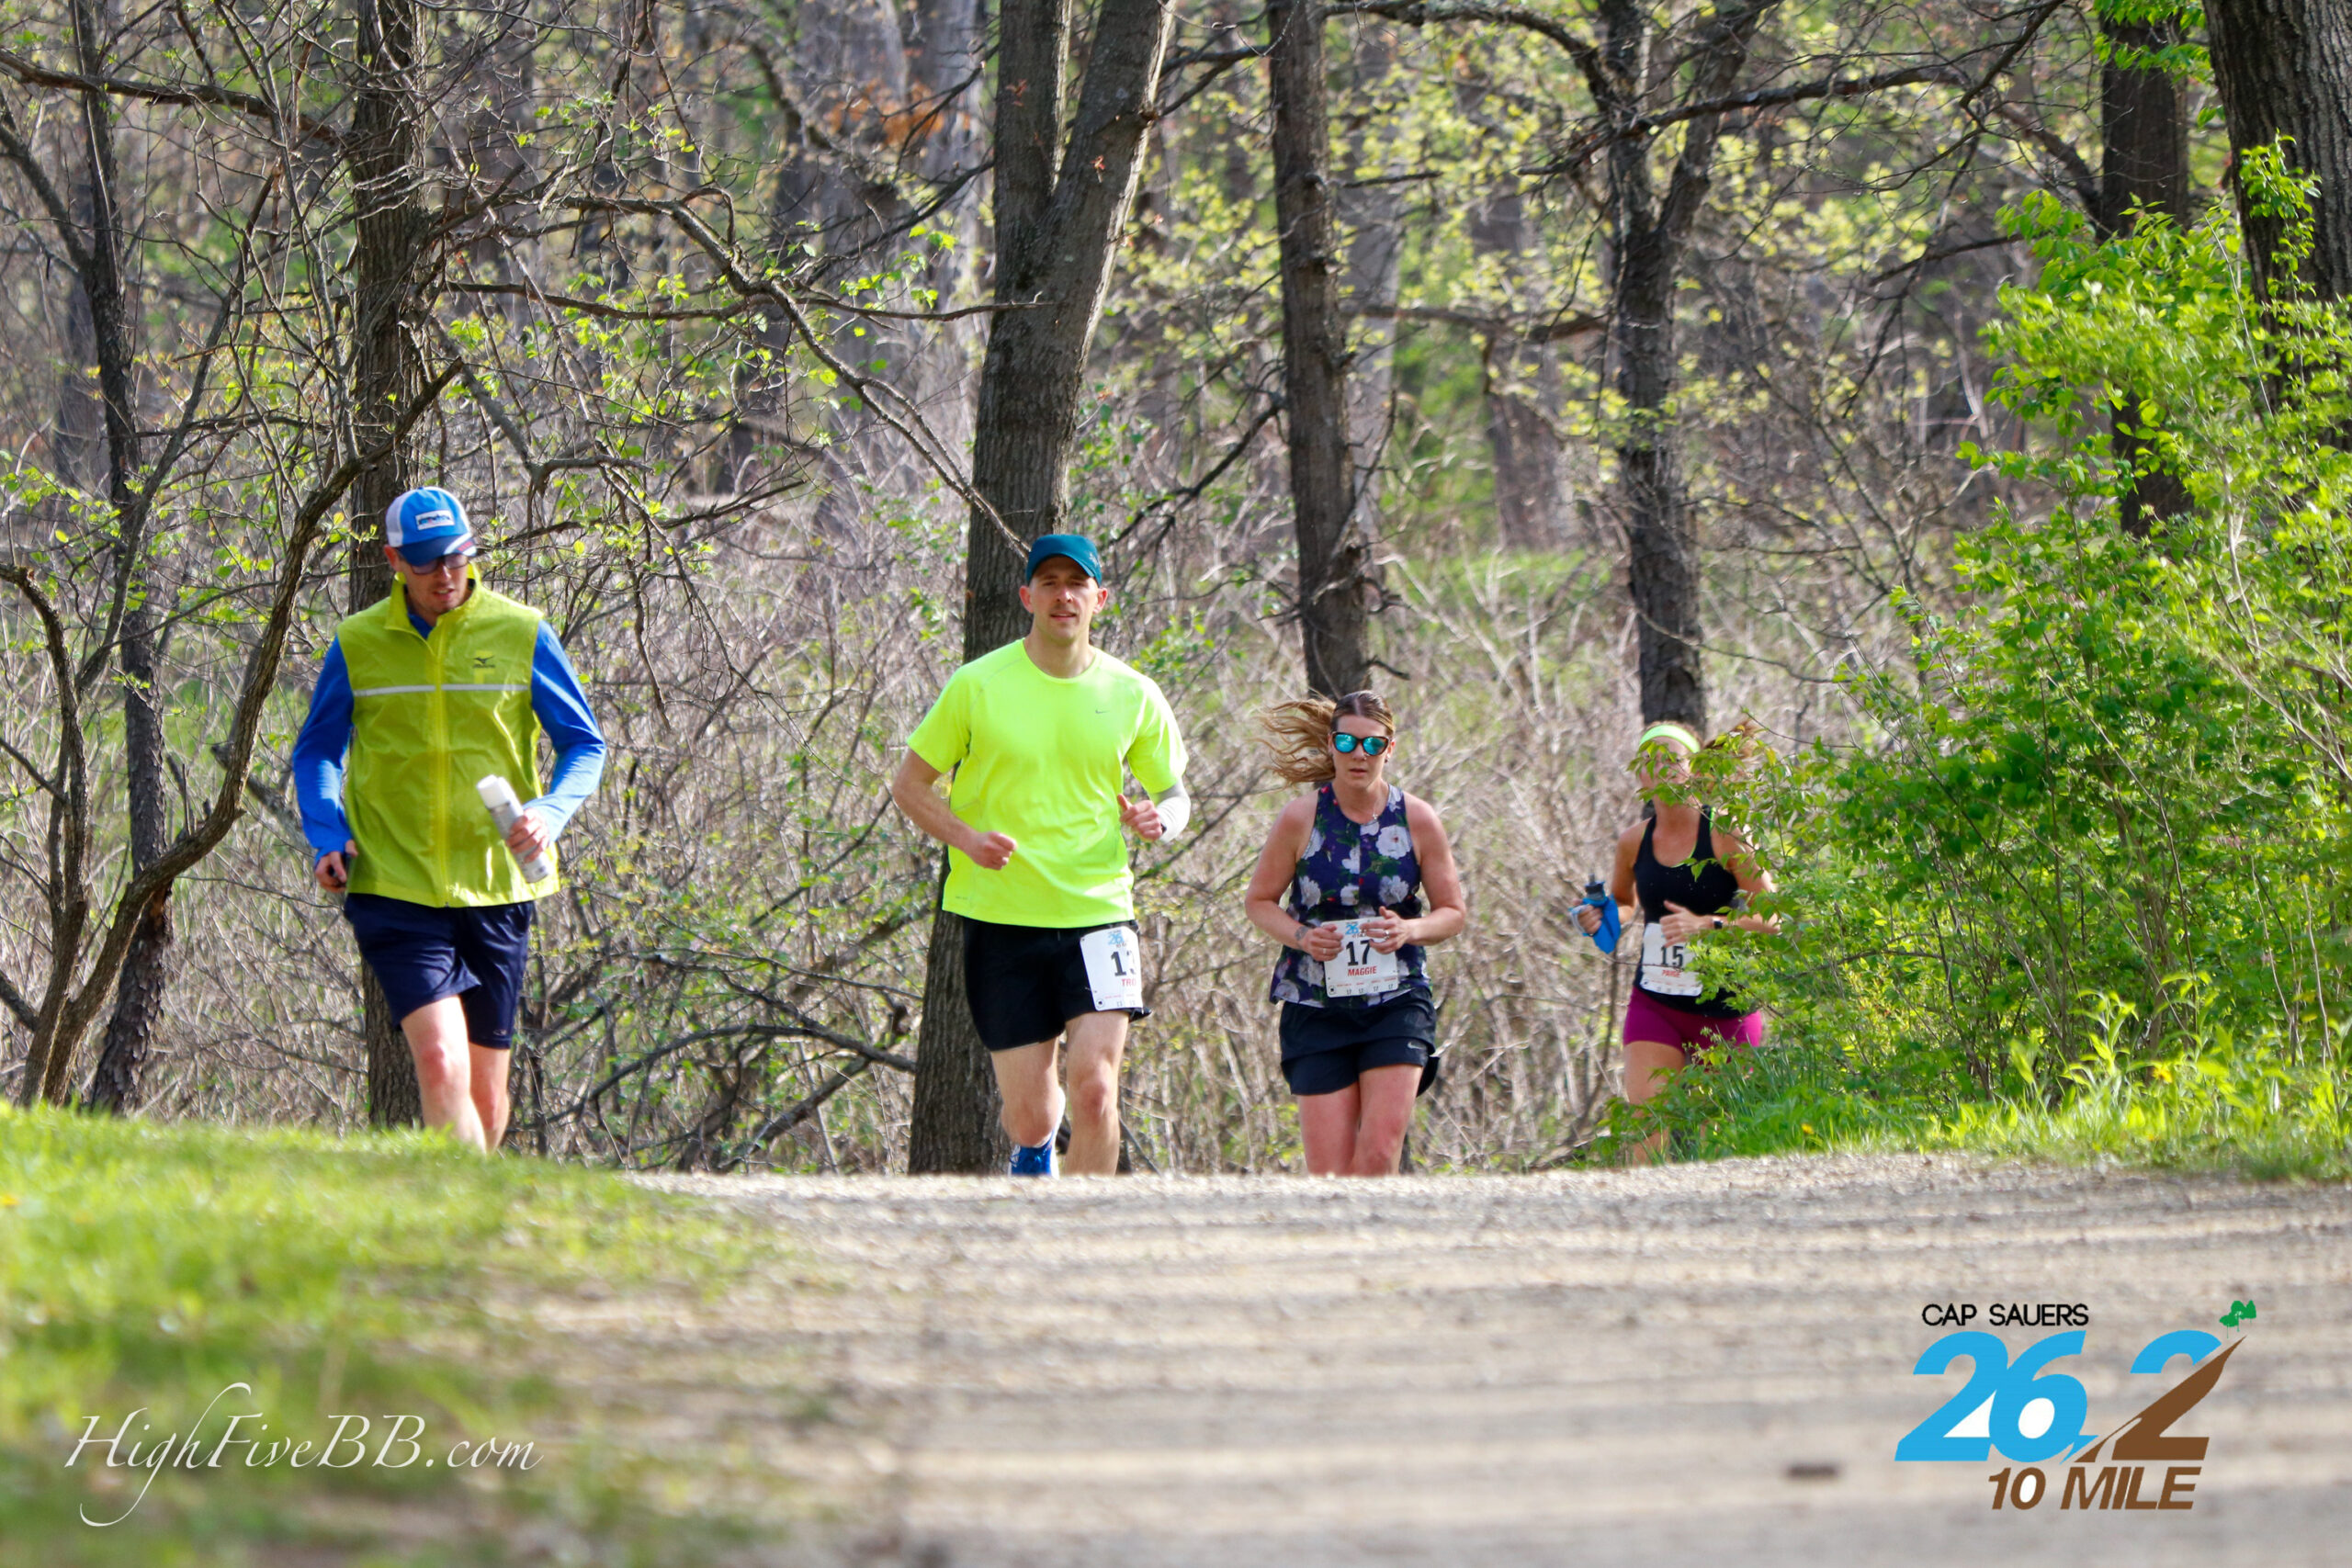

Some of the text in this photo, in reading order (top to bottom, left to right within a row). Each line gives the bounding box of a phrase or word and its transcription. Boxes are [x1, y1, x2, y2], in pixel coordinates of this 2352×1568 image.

[1346, 940, 1374, 966] 17
[1661, 945, 1684, 968] 15
[1348, 966, 1377, 976] MAGGIE
